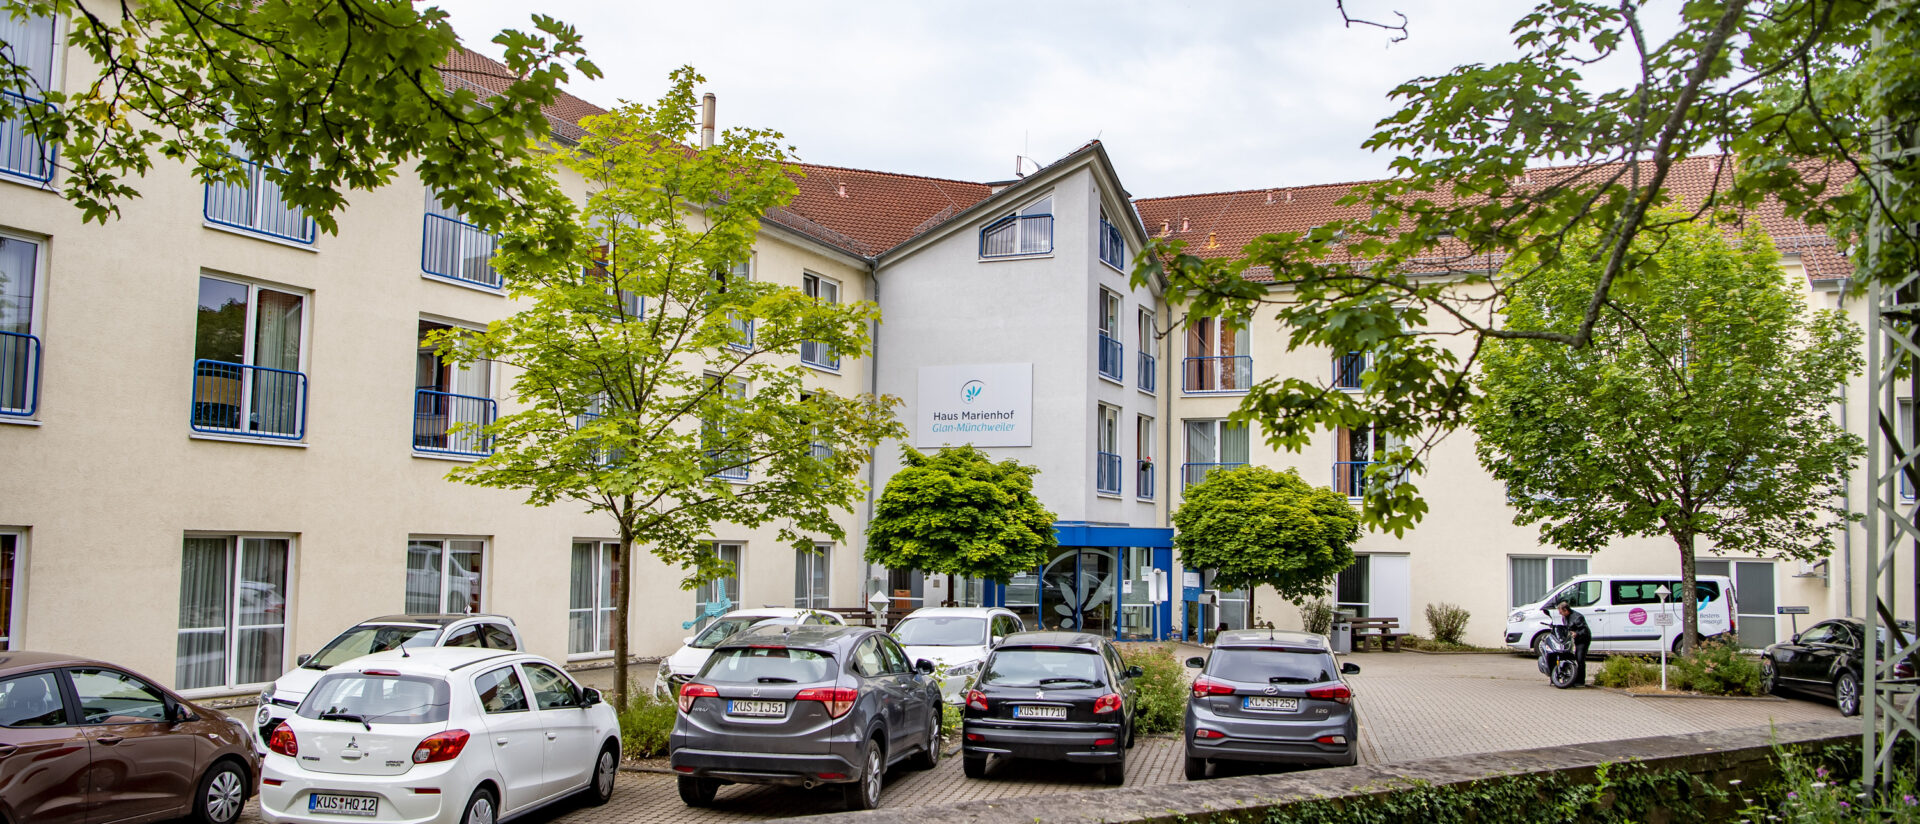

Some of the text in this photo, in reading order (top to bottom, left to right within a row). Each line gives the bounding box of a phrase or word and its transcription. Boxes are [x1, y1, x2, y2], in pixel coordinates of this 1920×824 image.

[933, 410, 1015, 421] Haus Marienhof
[932, 422, 1015, 433] Glan-Münchweiler
[733, 701, 753, 712] KUS
[1249, 698, 1296, 708] KL SH 252
[1019, 706, 1066, 717] KUS TT 710
[316, 796, 376, 811] KUS HQ 12
